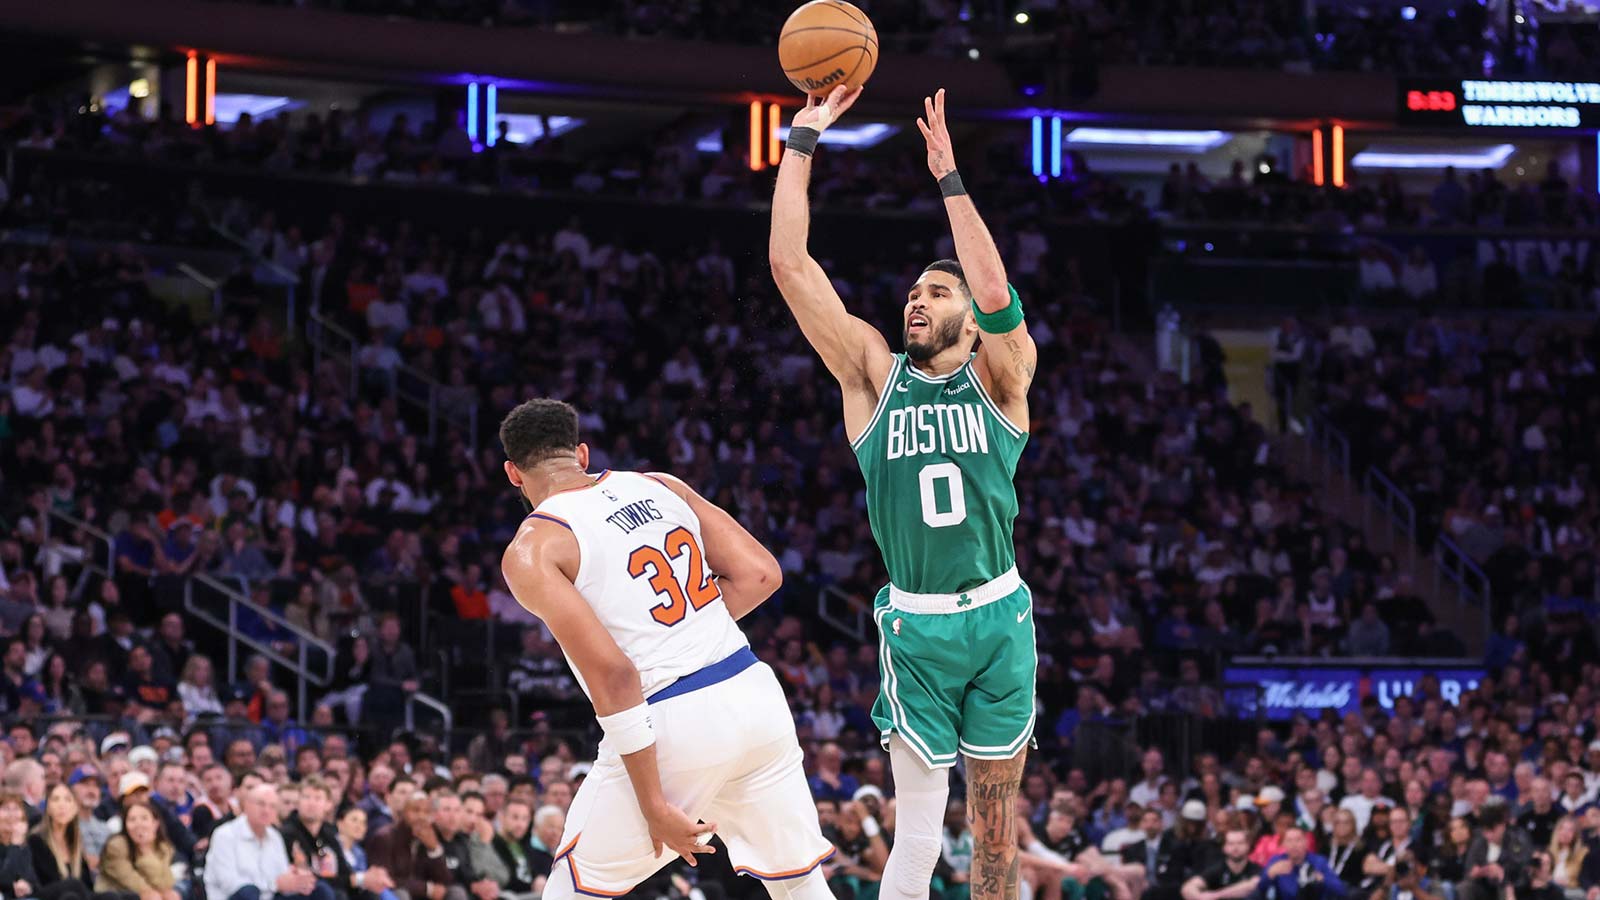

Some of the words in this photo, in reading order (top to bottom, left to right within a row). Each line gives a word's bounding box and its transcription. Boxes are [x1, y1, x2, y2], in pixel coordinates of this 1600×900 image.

[1461, 105, 1581, 127] WARRIORS
[887, 404, 989, 460] BOSTON
[605, 499, 663, 535] TOWNS
[918, 462, 967, 528] 0
[627, 526, 722, 627] 32
